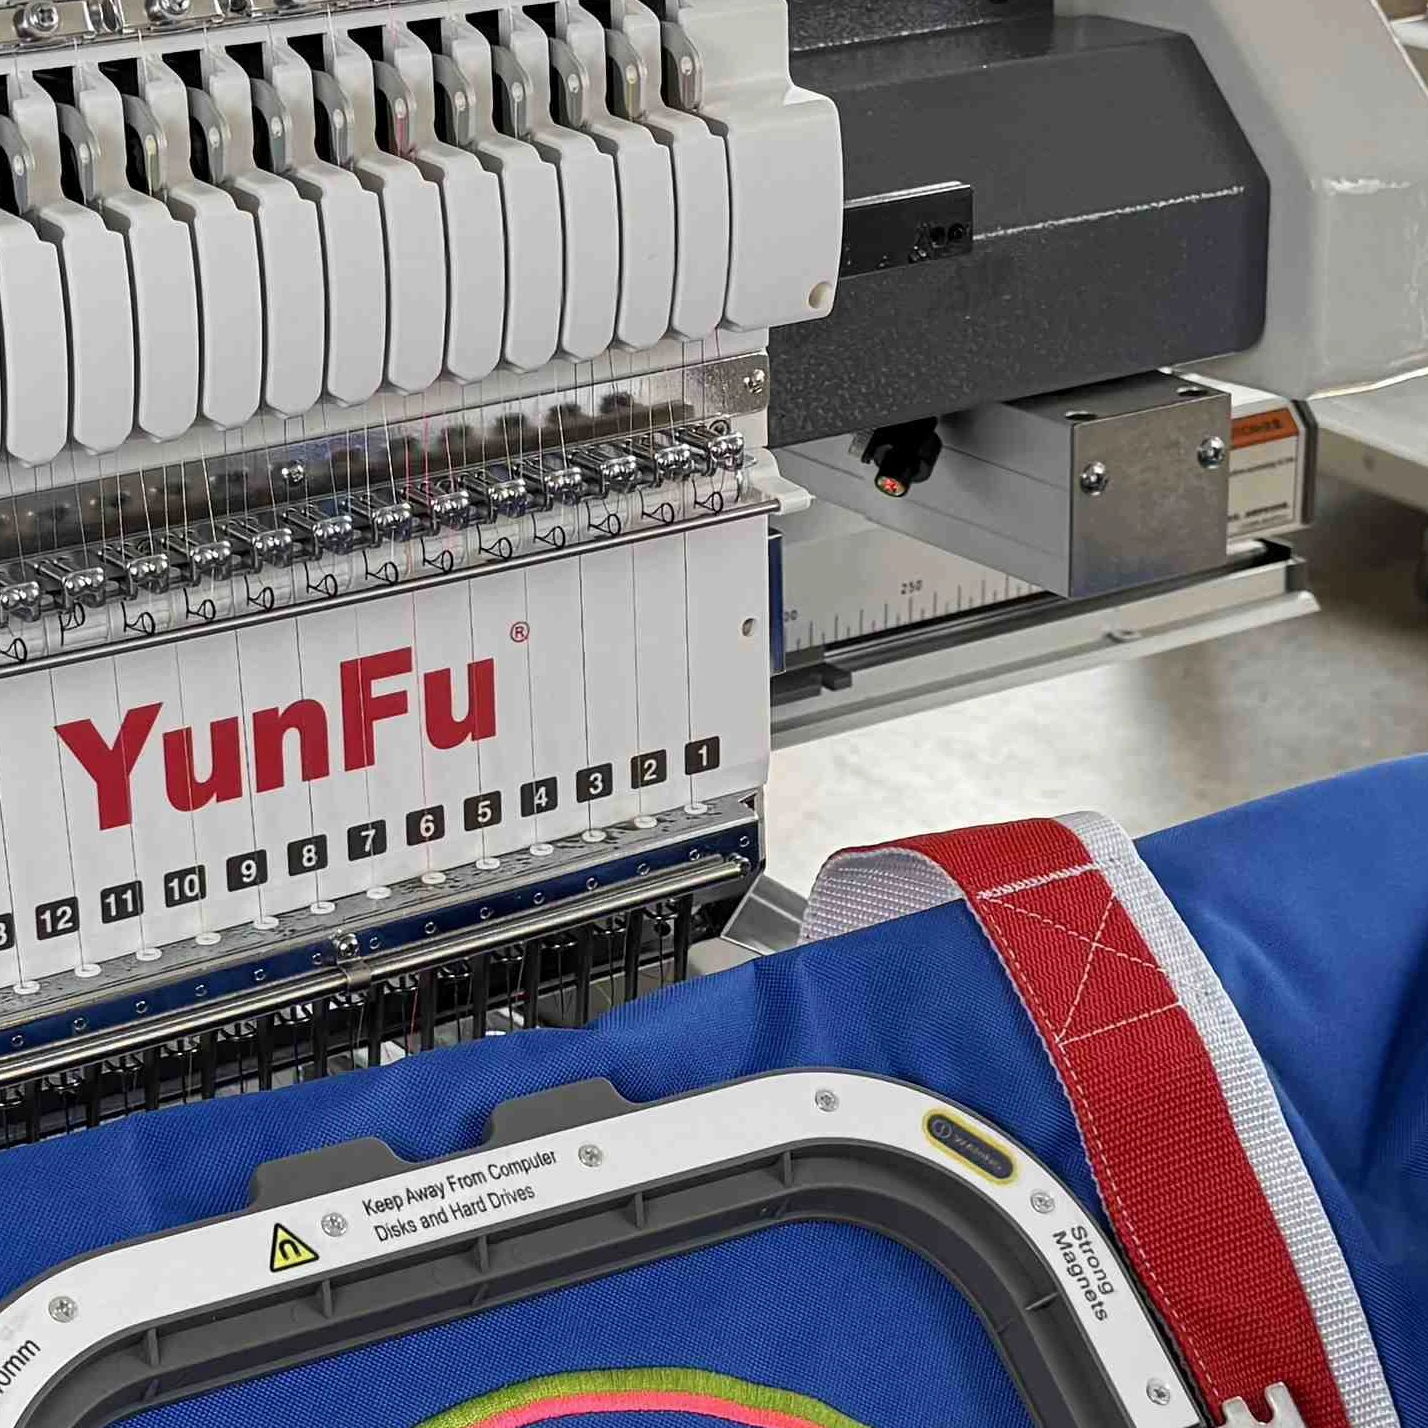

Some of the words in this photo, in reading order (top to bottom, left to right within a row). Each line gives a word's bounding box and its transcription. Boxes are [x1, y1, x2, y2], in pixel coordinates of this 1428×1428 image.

[901, 580, 922, 595] 250
[53, 645, 497, 831] YunFu
[41, 907, 74, 933] 12
[105, 890, 134, 916] 11
[168, 874, 201, 900] 10
[362, 1194, 404, 1217] Keep
[406, 1182, 445, 1205] Away
[446, 1171, 487, 1193] From
[487, 1149, 557, 1181] Computer
[373, 1219, 417, 1242] Disks
[419, 1208, 449, 1229] and
[449, 1196, 487, 1220] Hard
[487, 1185, 535, 1209] Drives
[1052, 1230, 1108, 1322] Magnets
[1071, 1225, 1115, 1295] Strong
